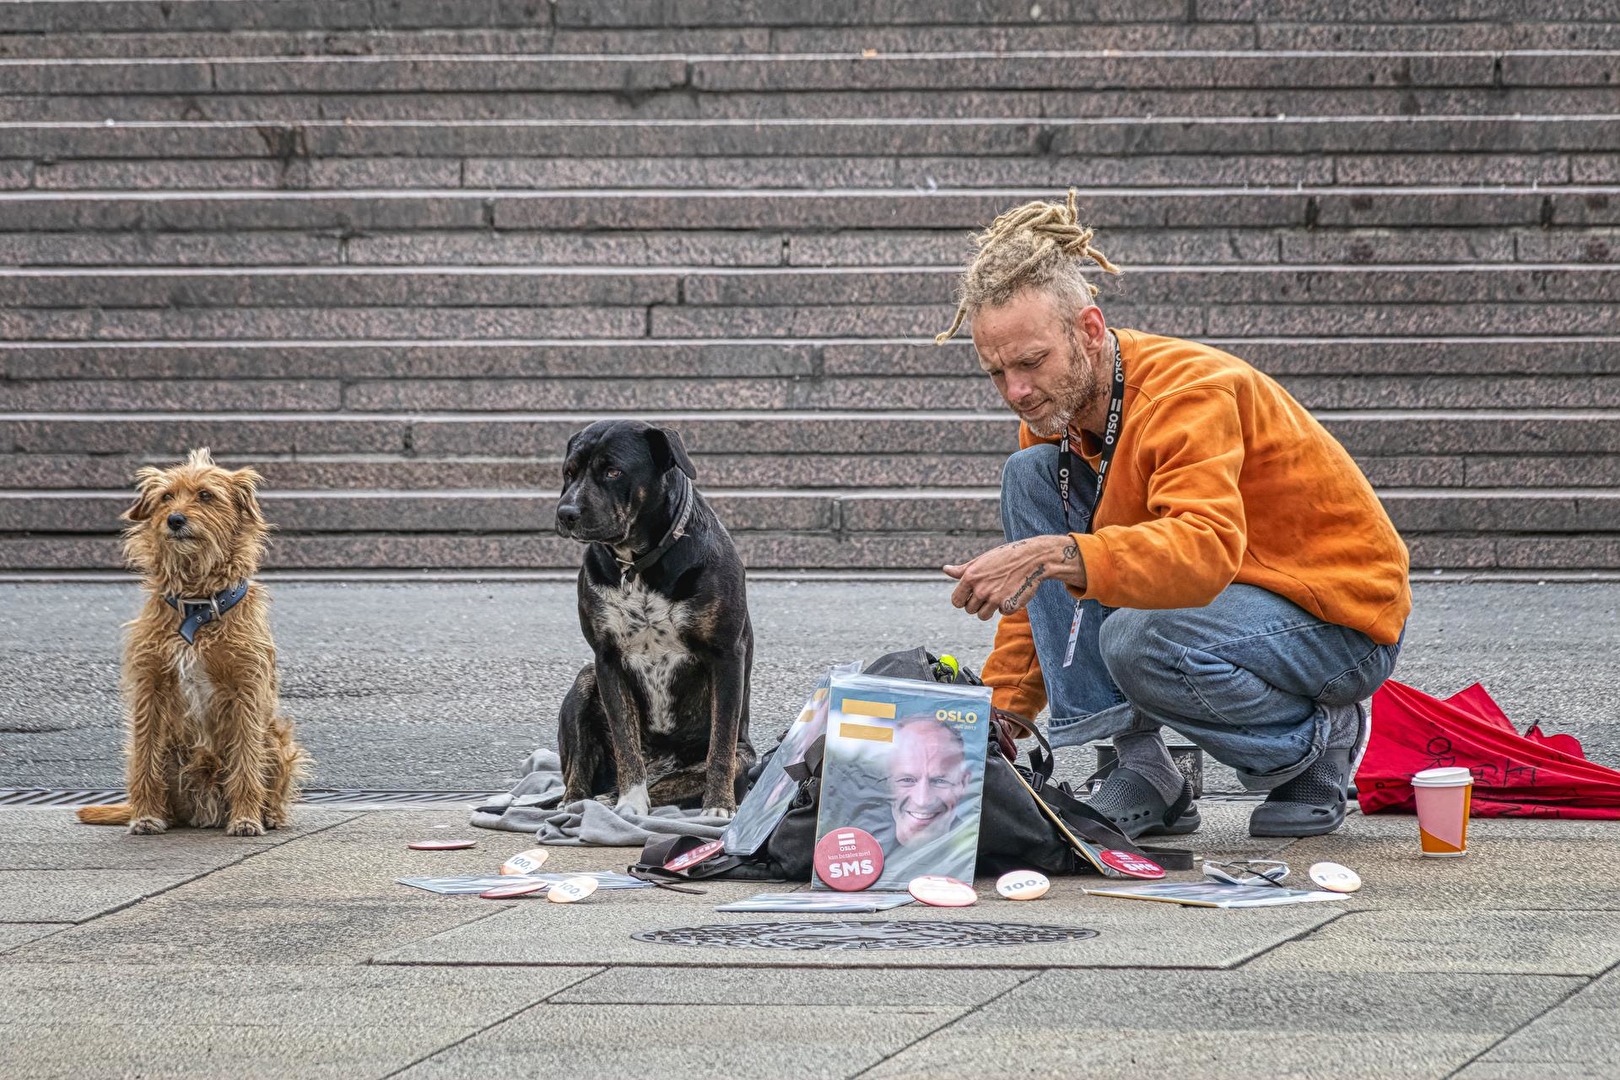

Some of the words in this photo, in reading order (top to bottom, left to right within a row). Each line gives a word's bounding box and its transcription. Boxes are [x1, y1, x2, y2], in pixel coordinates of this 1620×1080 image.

[1115, 352, 1124, 382] OSLO
[1105, 413, 1119, 445] OSLO
[1059, 468, 1069, 499] OSLO
[935, 709, 978, 724] OSLO
[829, 859, 874, 879] SMS
